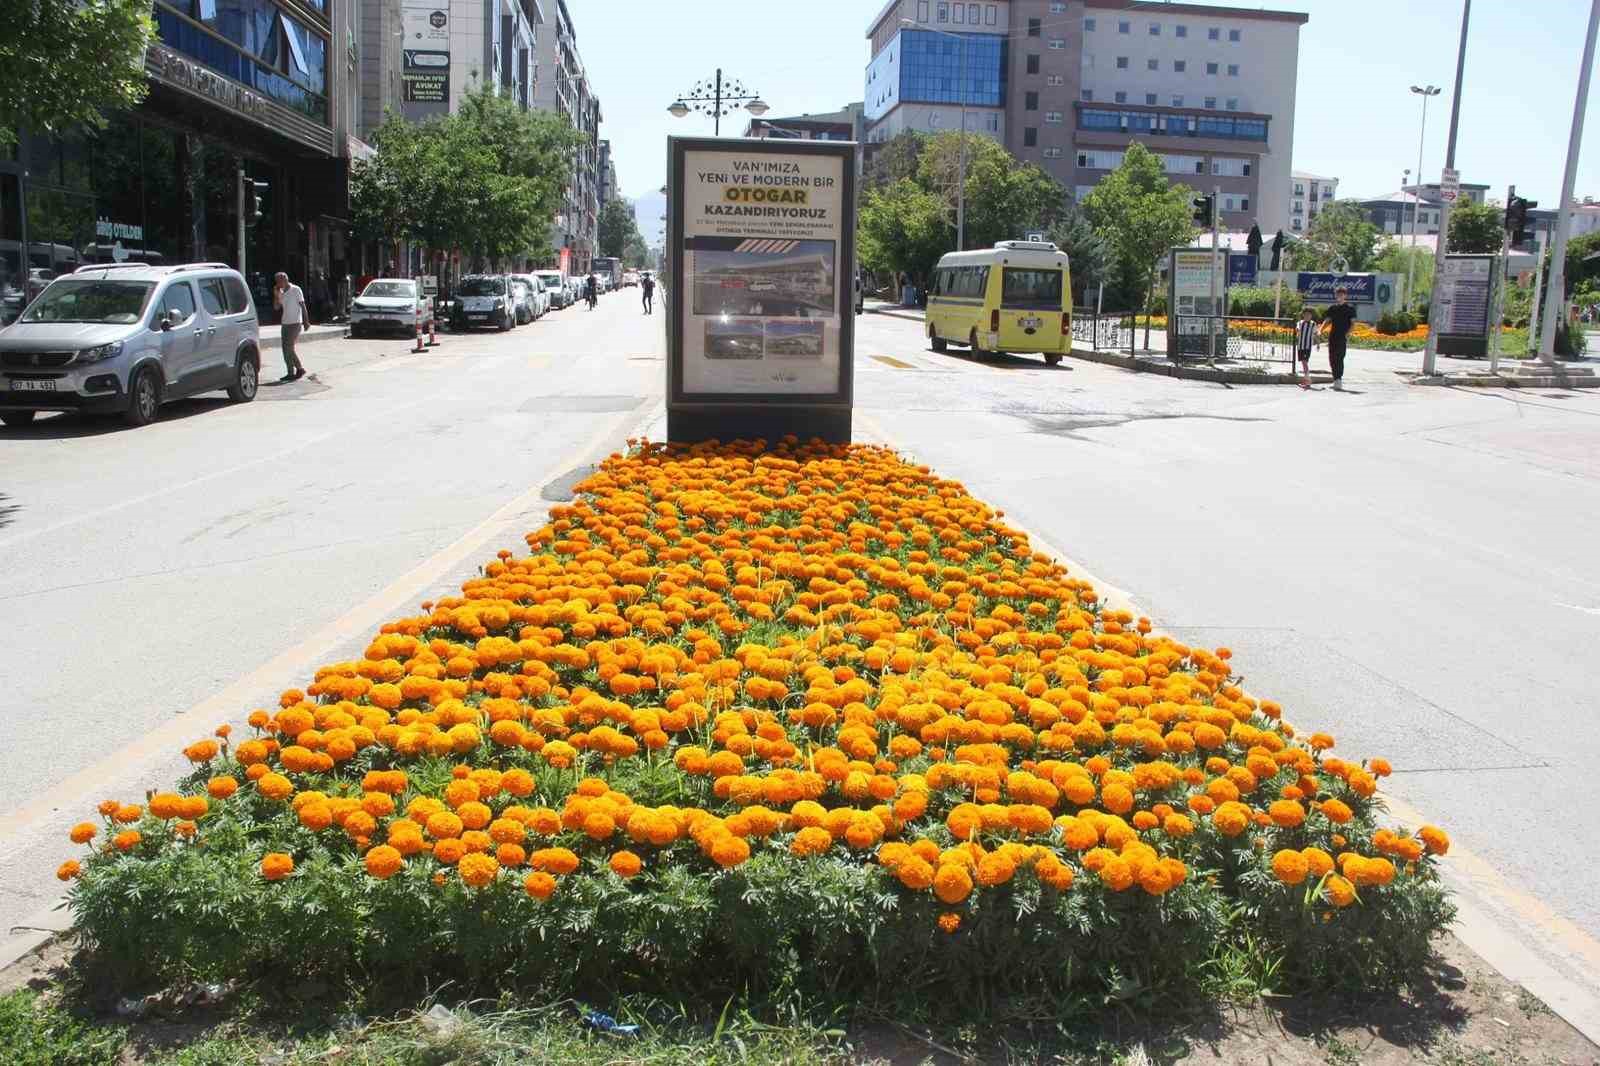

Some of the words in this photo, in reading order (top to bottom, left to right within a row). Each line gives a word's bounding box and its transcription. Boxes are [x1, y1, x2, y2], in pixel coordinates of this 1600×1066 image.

[733, 161, 800, 174] VAN'IMIZA
[698, 172, 728, 184] YENİ
[733, 174, 749, 184] VE
[753, 175, 809, 186] MODERN
[813, 176, 834, 187] BİR
[725, 187, 807, 203] OTOGAR
[704, 205, 827, 219] KAZANDIRIYORUZ
